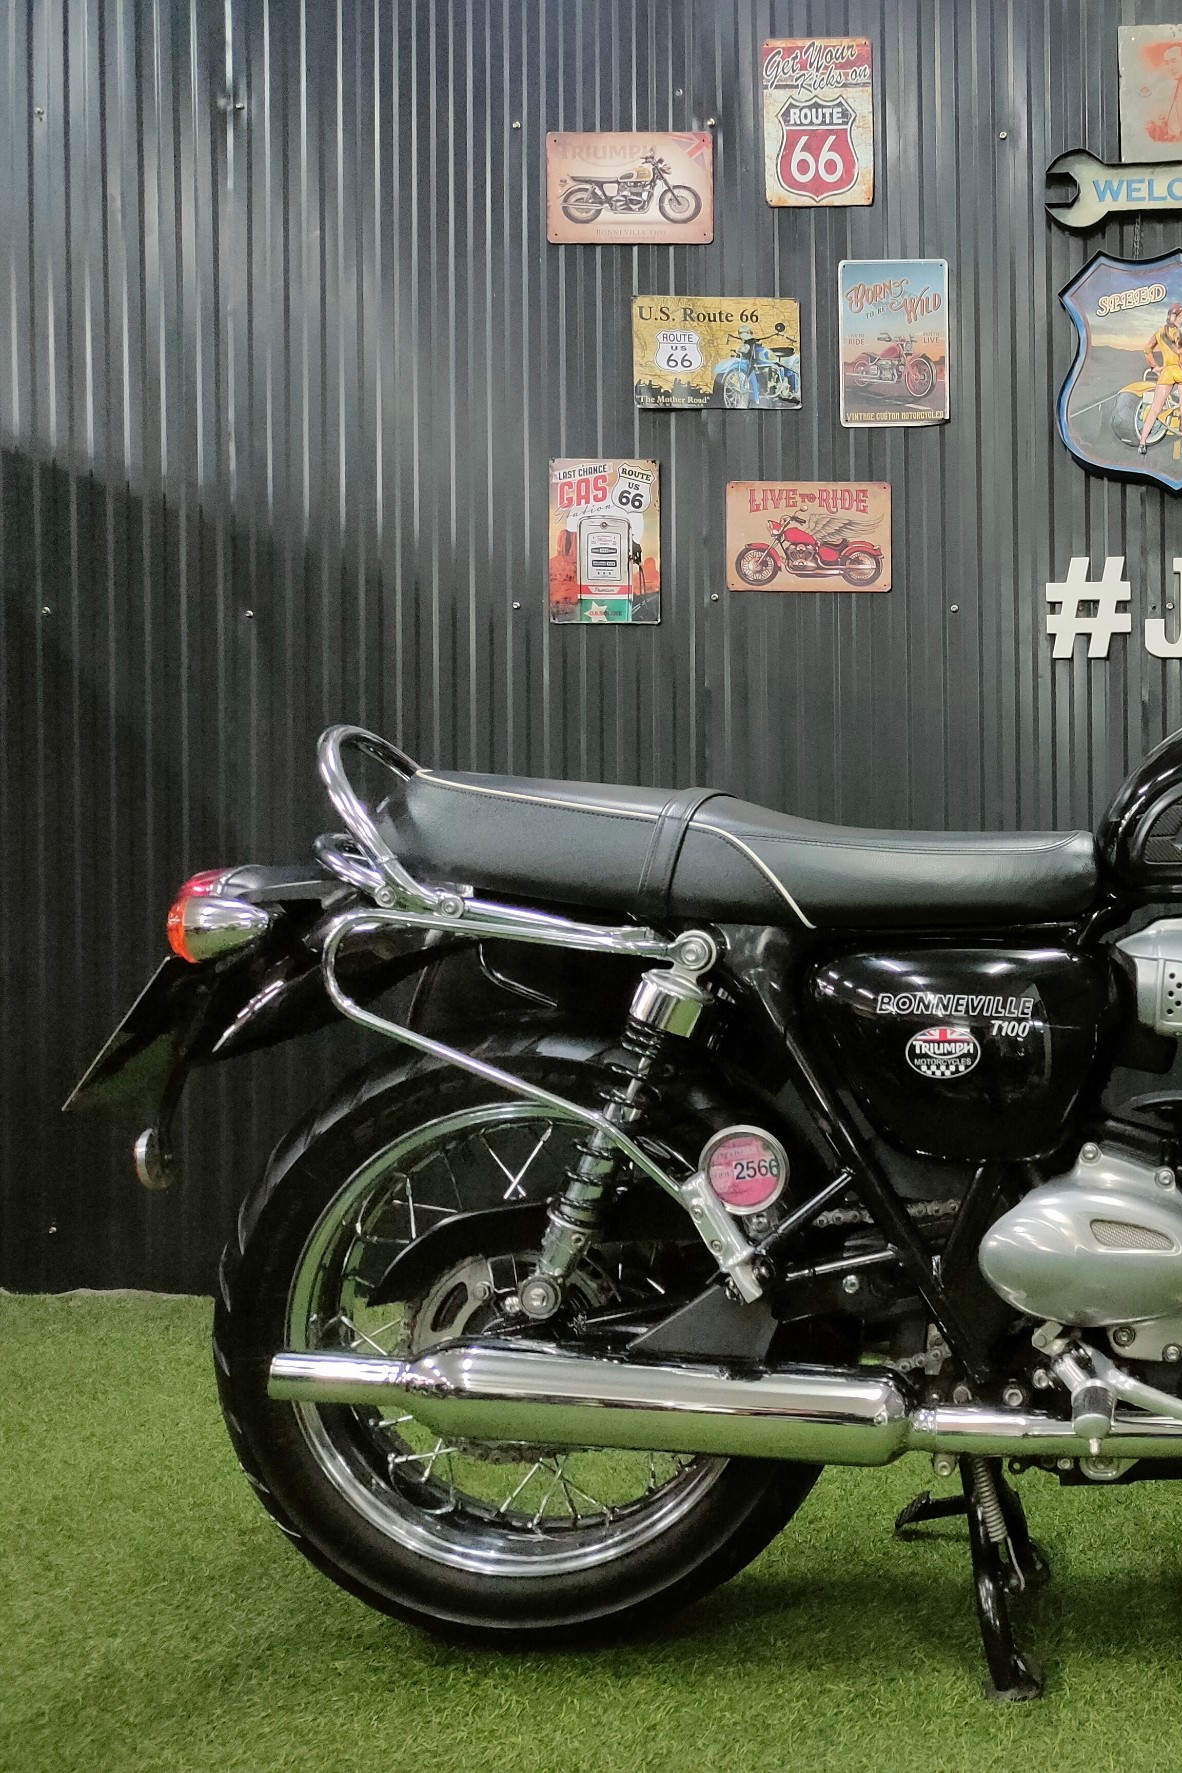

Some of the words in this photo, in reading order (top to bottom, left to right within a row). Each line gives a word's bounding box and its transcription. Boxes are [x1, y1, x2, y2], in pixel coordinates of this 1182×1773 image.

[764, 48, 799, 88] Get
[803, 41, 857, 72] Your
[794, 68, 844, 95] Kicks
[850, 65, 869, 81] on
[789, 107, 843, 125] ROUTE
[560, 144, 657, 161] TRIUMPH
[790, 135, 844, 183] 66
[845, 279, 909, 314] BORN
[889, 286, 942, 324] WILD
[1096, 283, 1167, 317] SPEED
[638, 305, 676, 321] U.S.
[682, 307, 734, 323] Route
[740, 308, 759, 324] 66
[865, 311, 875, 320] TO
[877, 306, 886, 316] BE
[662, 333, 694, 343] ROUTE
[848, 338, 865, 346] RIDE
[923, 336, 940, 344] LIVE
[666, 353, 693, 369] 66
[657, 395, 686, 403] Mother
[846, 412, 875, 421] VINTAGE
[876, 411, 900, 420] CUSTOM
[901, 410, 944, 420] MOTORCYCLES
[558, 469, 576, 481] LAST
[578, 463, 608, 477] CHANCE
[620, 467, 652, 482] ROUTE
[559, 475, 608, 509] GAS
[628, 481, 640, 491] US
[618, 489, 644, 510] 66
[748, 488, 799, 514] LIVE
[798, 493, 817, 503] TO
[817, 488, 869, 515] RIDE
[554, 504, 615, 525] Station
[876, 993, 1034, 1018] BONNEVILLE
[990, 1020, 1030, 1038] T100
[912, 1040, 974, 1056] TRIUMPH
[914, 1058, 972, 1066] MOTORCYCLES
